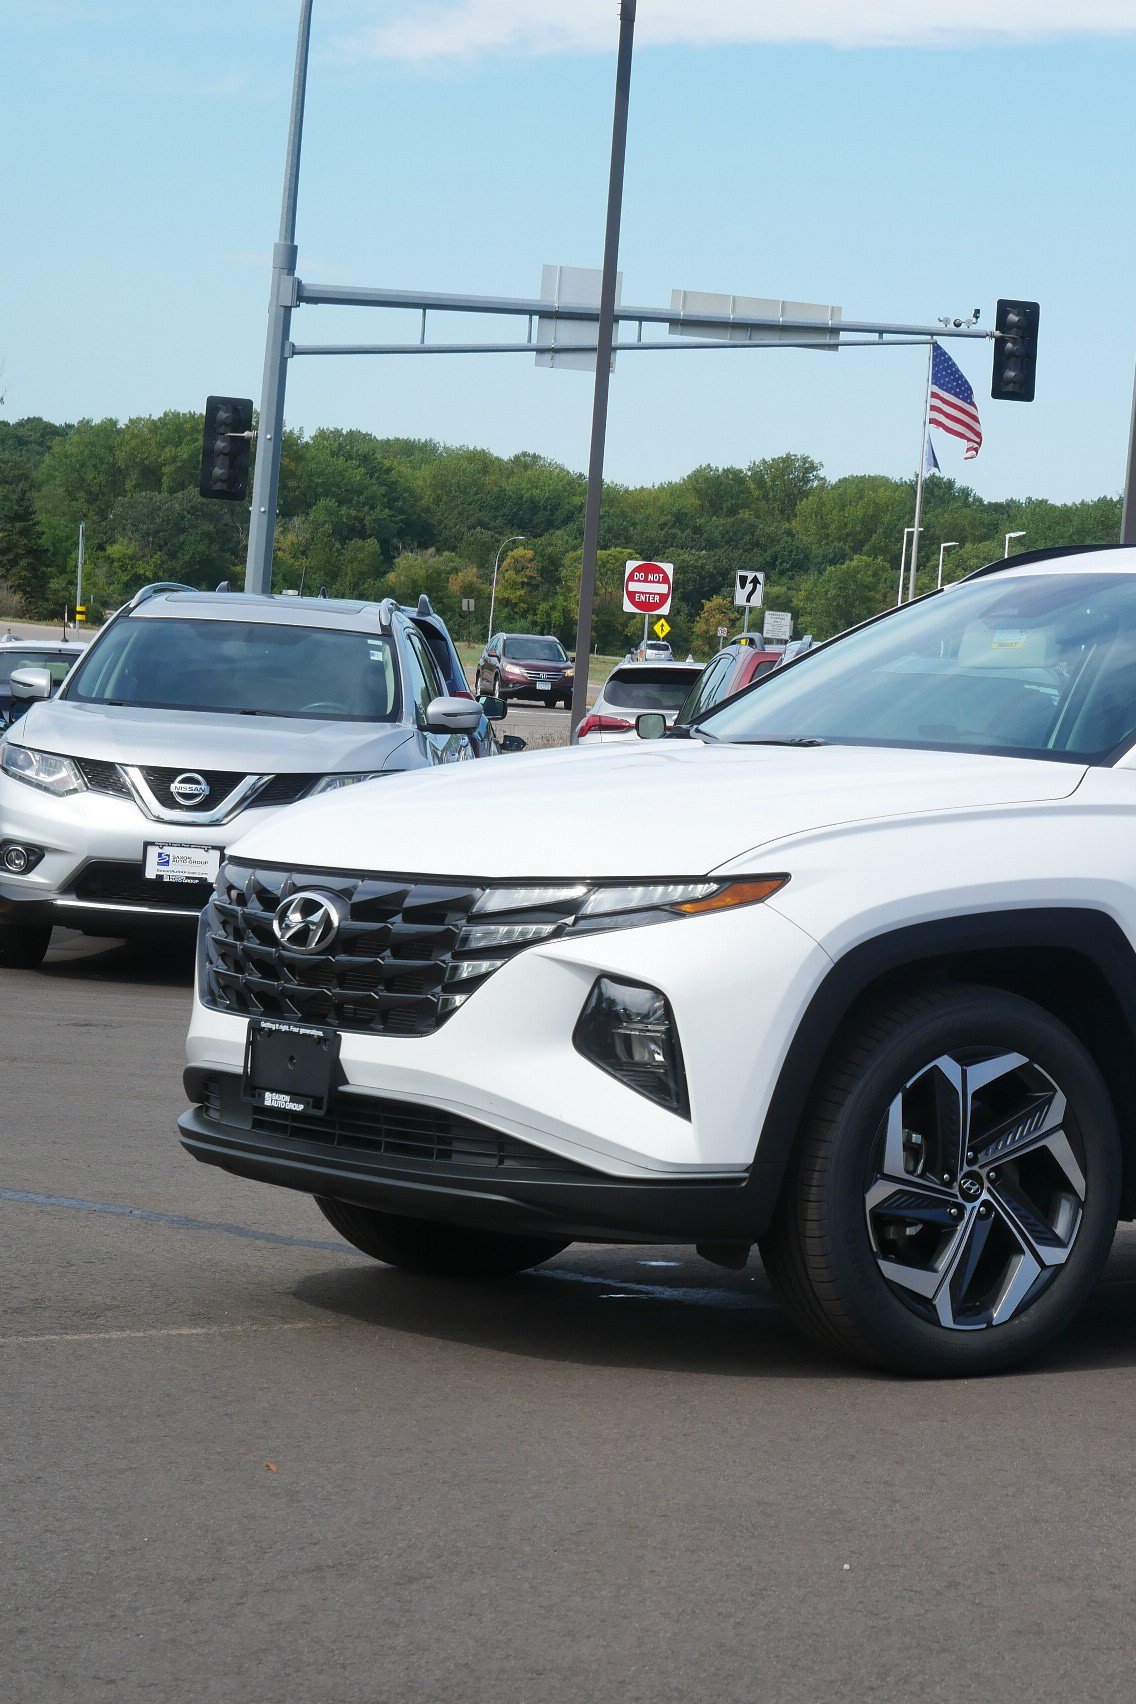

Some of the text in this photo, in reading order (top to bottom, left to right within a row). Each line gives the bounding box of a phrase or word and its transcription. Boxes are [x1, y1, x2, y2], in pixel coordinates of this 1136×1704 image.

[648, 573, 664, 582] NOT
[635, 593, 660, 603] ENTER
[174, 785, 206, 793] NISSAN
[272, 1093, 290, 1102] SAXON
[271, 1099, 305, 1111] AUTO GROUP
